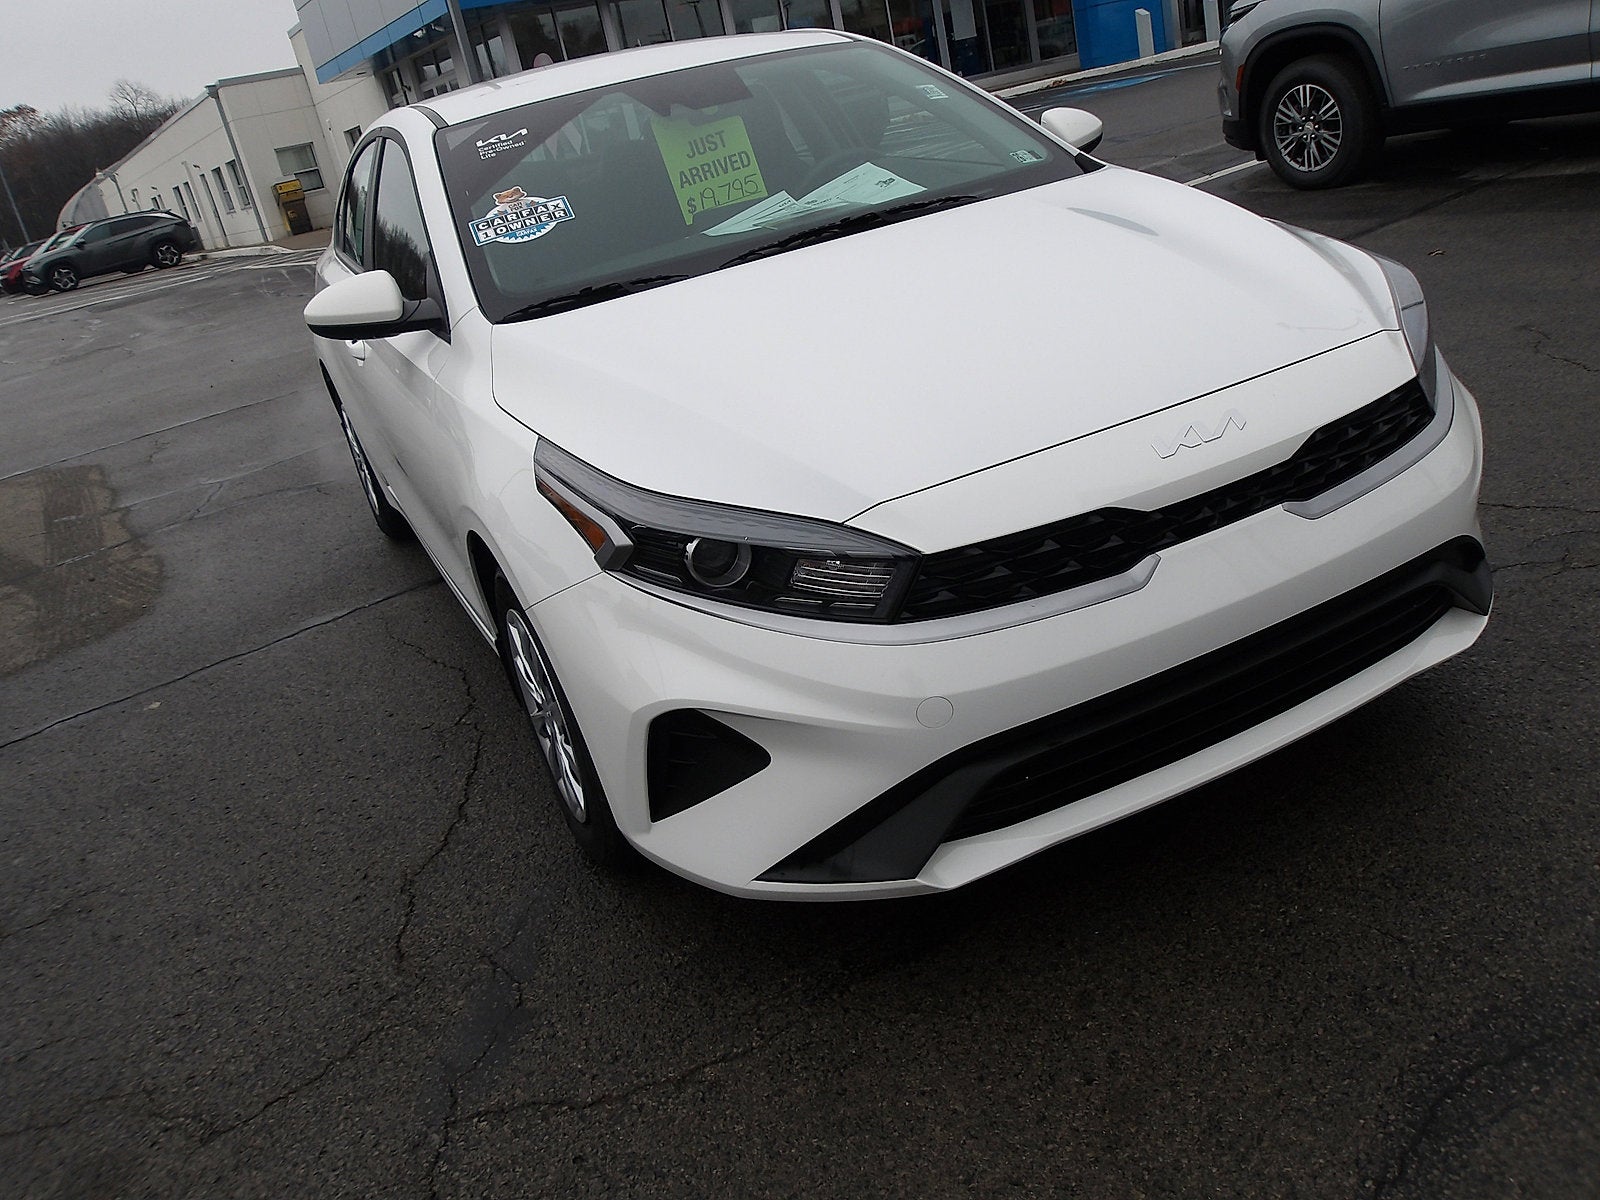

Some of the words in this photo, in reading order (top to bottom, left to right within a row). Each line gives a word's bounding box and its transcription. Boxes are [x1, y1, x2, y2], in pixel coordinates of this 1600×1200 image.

[476, 128, 528, 147] KIA
[478, 140, 513, 152] Certified
[480, 141, 525, 156] Pre-Owned
[686, 130, 726, 159] JUST
[480, 152, 497, 160] Lite
[678, 150, 751, 189] ARRIVED
[478, 202, 561, 230] CARFAX
[482, 231, 491, 239] 1
[496, 210, 566, 234] OWNER
[1148, 408, 1247, 459] KIA
